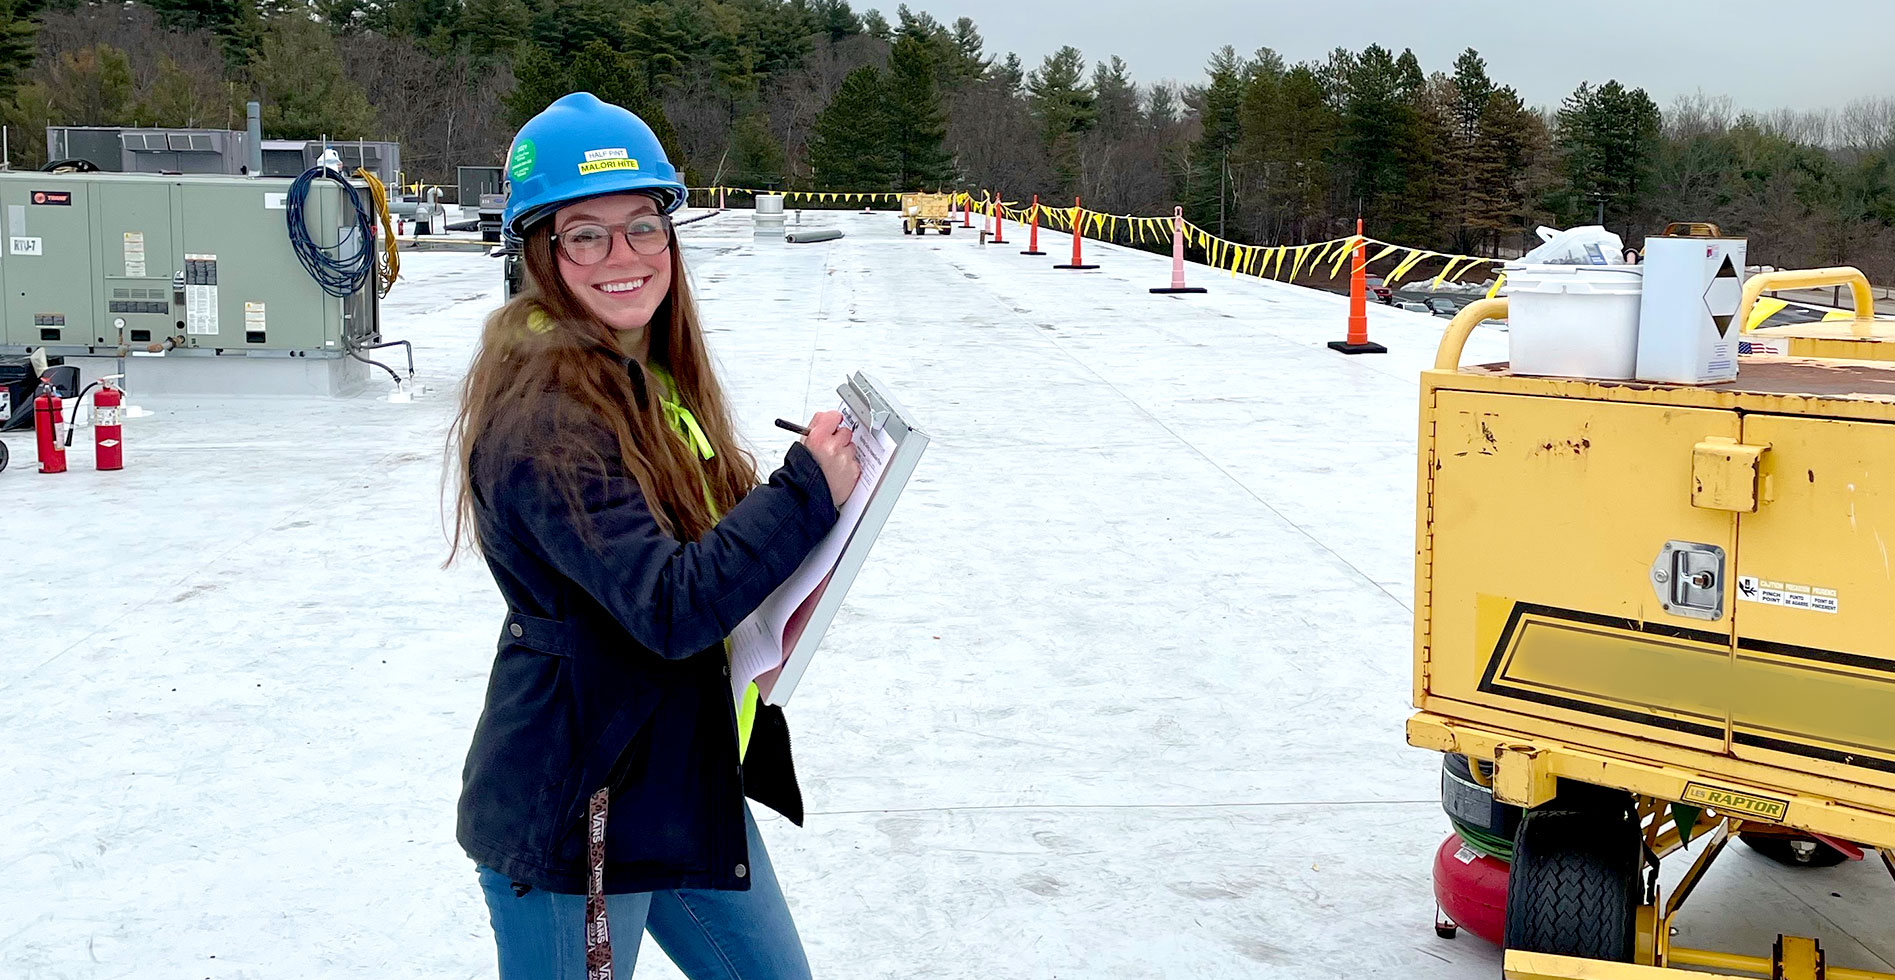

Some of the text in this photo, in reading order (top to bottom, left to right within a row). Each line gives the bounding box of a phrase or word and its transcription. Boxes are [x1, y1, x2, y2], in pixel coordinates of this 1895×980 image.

[581, 160, 637, 172] MALORI HITE
[13, 239, 36, 251] RTU-7
[1762, 590, 1781, 598] PINCH
[1762, 596, 1780, 604] POINT
[1690, 788, 1781, 815] LES RAPTOR
[592, 811, 606, 844] VANS
[596, 911, 609, 944] VANS
[599, 962, 612, 980] VA
